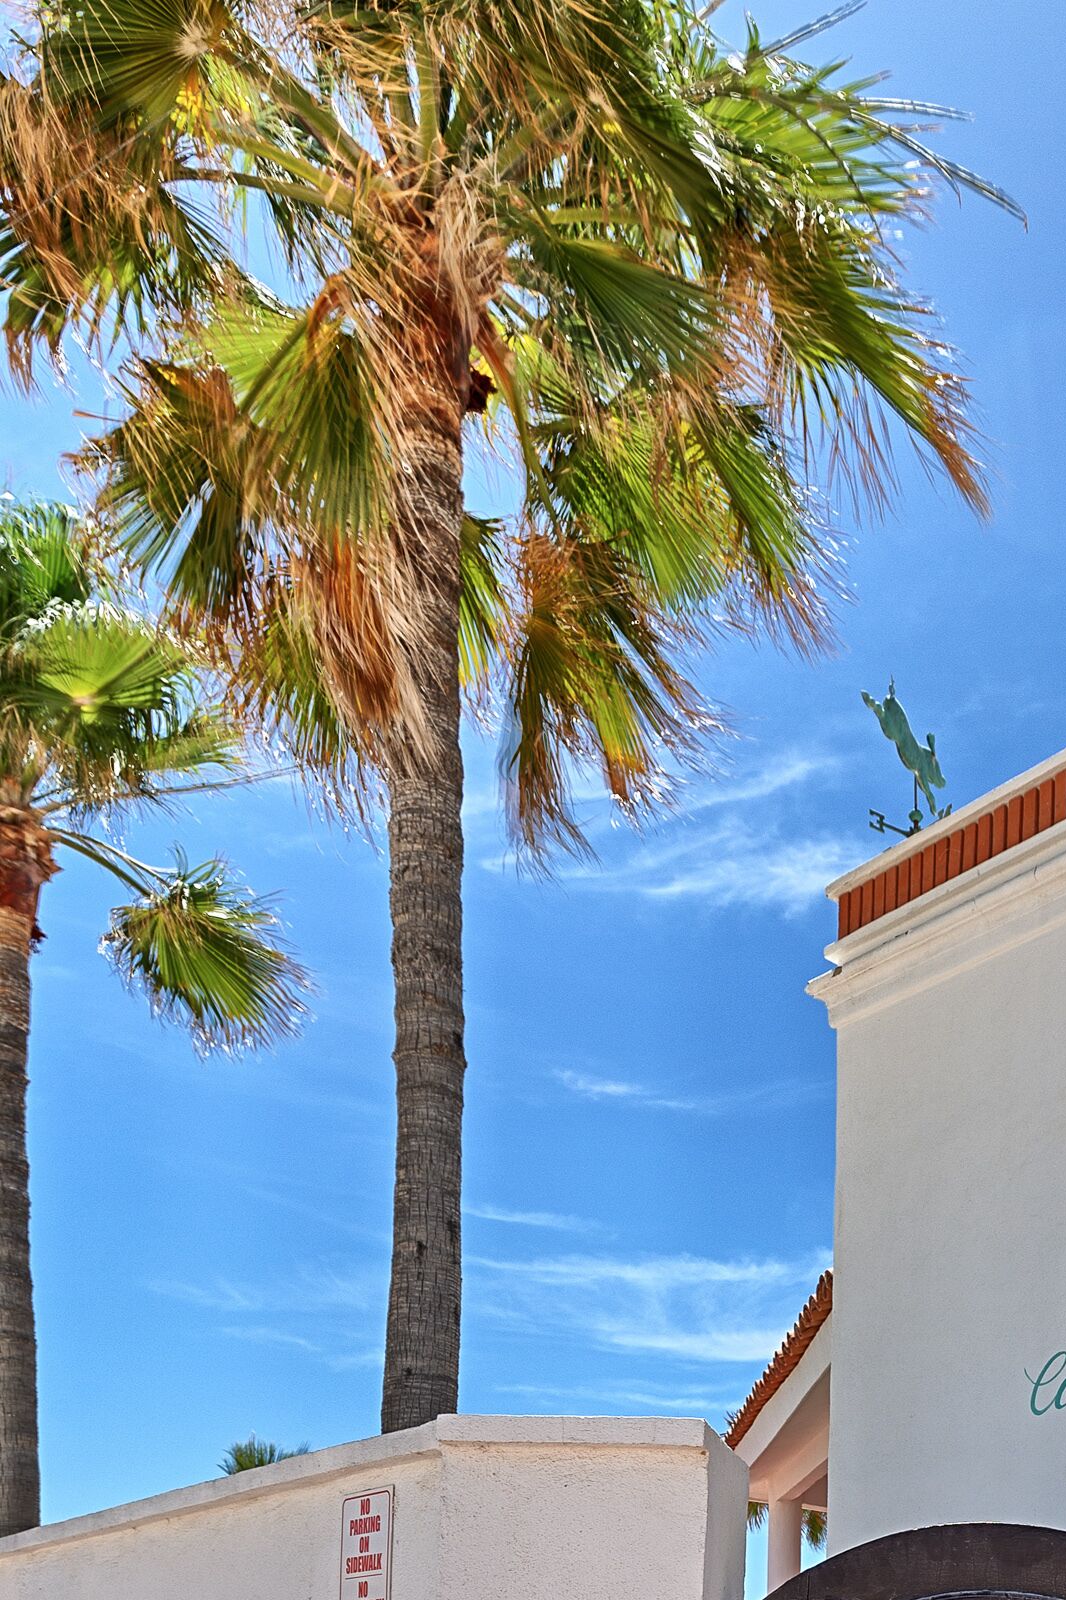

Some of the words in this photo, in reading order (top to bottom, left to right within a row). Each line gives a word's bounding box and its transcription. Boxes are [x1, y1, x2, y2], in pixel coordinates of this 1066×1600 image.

[360, 1498, 370, 1515] NO
[349, 1515, 381, 1536] PARKING
[359, 1536, 369, 1553] ON
[346, 1553, 382, 1574] SIDEWALK
[358, 1581, 368, 1598] NO
